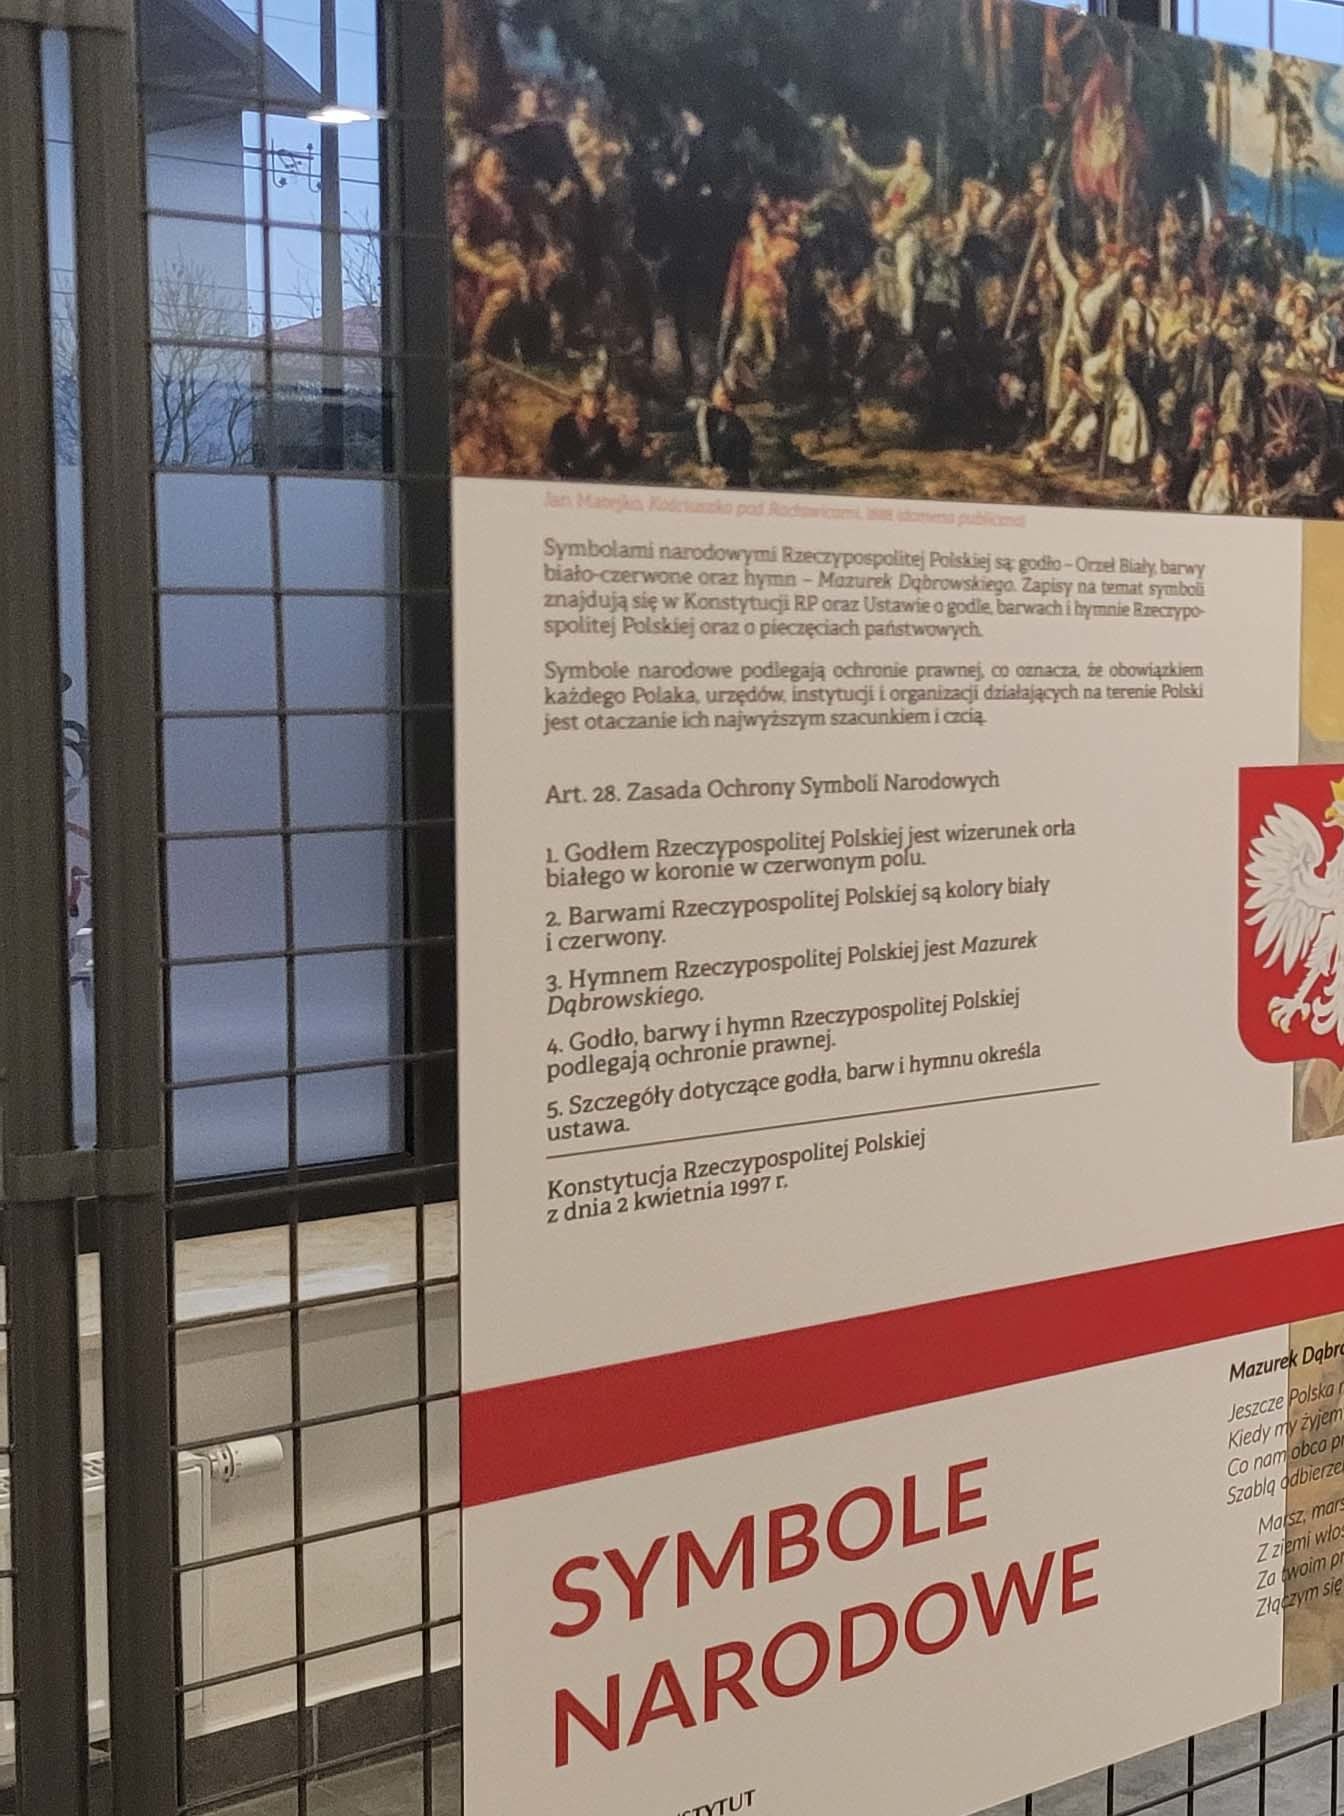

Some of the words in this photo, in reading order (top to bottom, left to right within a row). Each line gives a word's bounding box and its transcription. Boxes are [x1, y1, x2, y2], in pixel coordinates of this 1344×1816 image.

[543, 537, 654, 562] Symbolami
[658, 542, 778, 567] narodowymi
[780, 545, 926, 572] Rzeczypospolitej
[928, 550, 991, 574] Polskiej
[1017, 554, 1062, 575] godło
[1074, 555, 1116, 573] Orzeł
[1159, 558, 1205, 579] barwy
[543, 563, 692, 585] biało-czerwone
[696, 572, 739, 586] oraz
[743, 568, 797, 591] hymn
[817, 570, 892, 589] Mazurek
[1021, 576, 1073, 597] Zapisy
[1076, 581, 1096, 594] na
[1100, 578, 1144, 595] temat
[1147, 580, 1205, 599] symboli
[543, 591, 628, 614] znajdują
[631, 592, 658, 614] się
[683, 593, 790, 616] Konstytucji
[793, 595, 818, 612] RP
[820, 600, 860, 613] oraz
[863, 596, 930, 614] Ustawie
[995, 599, 1063, 616] barwach
[1073, 601, 1130, 620] hymnie
[1132, 602, 1204, 621] Rzeczypo-
[543, 616, 616, 639] spolitej
[621, 616, 696, 639] Polskiej
[698, 622, 740, 635] oraz
[758, 618, 860, 640] pieczęciach
[544, 660, 630, 684] Symbole
[637, 661, 732, 679] narodowe
[740, 661, 826, 683] podlegają
[832, 661, 908, 678] ochronie
[990, 666, 1010, 678] co
[1086, 661, 1103, 677] że
[1108, 661, 1204, 681] obowiązkiem
[544, 686, 626, 709] każdego
[791, 685, 874, 706] instytucji
[888, 684, 979, 705] organizacji
[982, 684, 1079, 704] działających
[1082, 688, 1102, 699] na
[1105, 684, 1157, 699] terenie
[1160, 683, 1204, 699] Polski
[544, 711, 578, 735] jest
[583, 710, 677, 729] otaczanie
[681, 710, 710, 728] ich
[713, 709, 826, 731] najwyższym
[829, 709, 931, 725] szacunkiem
[545, 784, 587, 804] Art.
[592, 783, 620, 802] 28.
[626, 780, 702, 801] Zasada
[706, 778, 795, 801] Ochrony
[799, 774, 878, 800] Symboli
[883, 770, 999, 794] Narodowych
[563, 840, 649, 862] Godłem
[655, 830, 825, 860] Rzeczypospolitej
[830, 826, 903, 851] Polskiej
[907, 825, 940, 850] jest
[945, 820, 1038, 843] wizerunek
[1041, 819, 1075, 839] orła
[545, 865, 625, 890] białego
[654, 858, 735, 882] koronie
[762, 855, 875, 876] czerwonym
[879, 847, 926, 874] polu.
[568, 899, 665, 925] Barwami
[671, 887, 840, 920] Rzeczypospolitej
[845, 882, 917, 908] Polskiej
[920, 886, 941, 906] są
[945, 879, 1003, 902] kolory
[1007, 874, 1049, 899] biały
[557, 930, 666, 951] czerwony.
[568, 967, 668, 994] Hymnem
[674, 947, 842, 981] Rzeczypospolitej
[847, 940, 919, 966] Polskiej
[923, 937, 955, 964] jest
[960, 931, 1036, 956] Mazurek
[547, 986, 704, 1019] Dąbrowskiego.
[568, 1027, 638, 1052] Godło,
[642, 1023, 710, 1045] barwy
[726, 1015, 785, 1040] hymn
[790, 994, 947, 1030] Rzeczypospolitej
[952, 987, 1020, 1013] Polskiej
[546, 1049, 650, 1085] podlegają
[654, 1039, 746, 1067] ochronie
[751, 1029, 836, 1062] prawnej.
[568, 1084, 673, 1115] Szczegóły
[678, 1076, 779, 1104] dotyczące
[783, 1065, 841, 1095] godła,
[846, 1062, 893, 1083] barw
[908, 1054, 973, 1079] hymnu
[977, 1042, 1041, 1067] określa
[546, 1117, 630, 1141] ustawa.
[547, 1164, 677, 1200] Konstytucja
[683, 1140, 848, 1181] Rzeczypospolitej
[854, 1130, 925, 1158] Polskiej
[563, 1196, 611, 1221] dnia
[633, 1180, 724, 1211] kwietnia
[730, 1177, 770, 1200] 1997
[771, 1175, 788, 1190] r.
[1229, 1349, 1297, 1382] Mazurek
[1229, 1397, 1283, 1422] Jeszcze
[1289, 1381, 1335, 1408] Polska
[1228, 1424, 1269, 1450] Kiedy
[1274, 1420, 1296, 1439] my
[1227, 1457, 1249, 1478] Co
[1254, 1450, 1287, 1471] nam
[1290, 1439, 1326, 1462] obca
[1227, 1476, 1275, 1505] Szablą
[1258, 1510, 1308, 1535] Marsz,
[549, 1457, 988, 1638] SYMBOLE
[1272, 1530, 1310, 1559] ziemi
[1255, 1569, 1275, 1590] Za
[1281, 1555, 1326, 1583] twoim
[1255, 1587, 1318, 1618] Złączym
[1322, 1576, 1342, 1599] się
[555, 1538, 1100, 1768] NARODOWE
